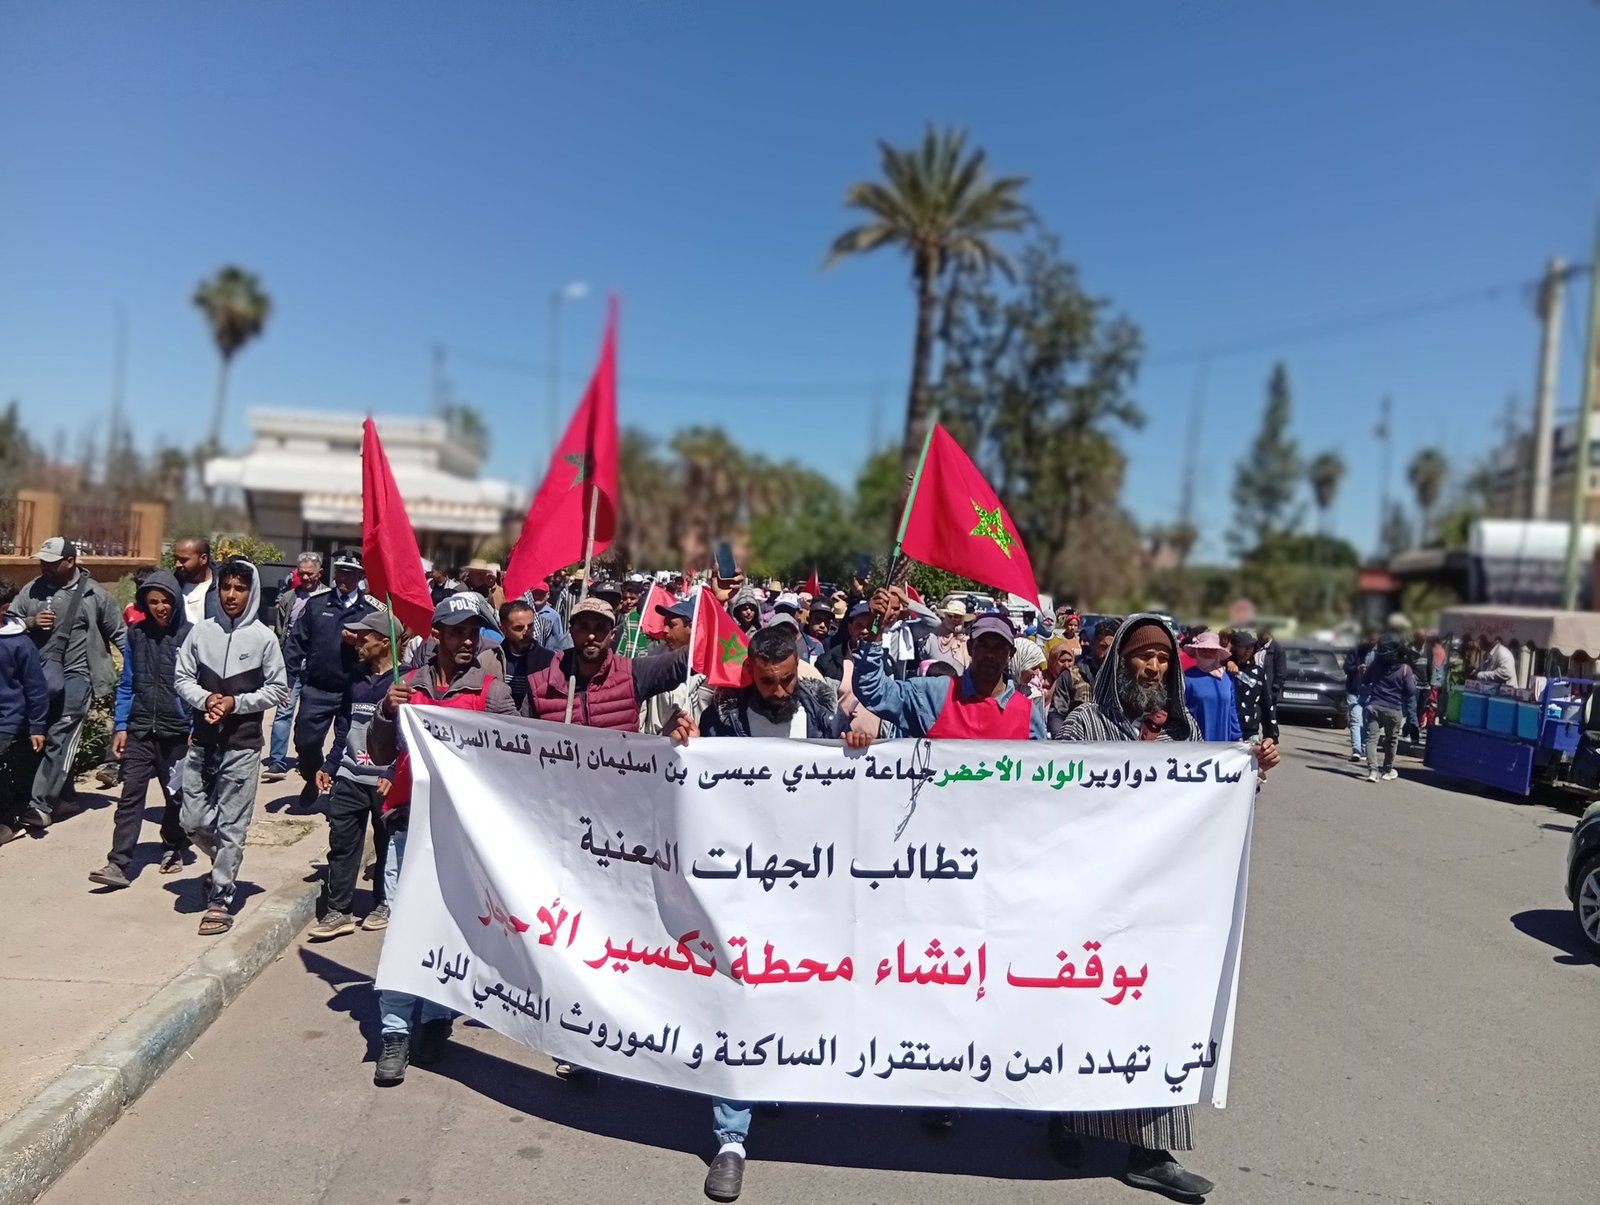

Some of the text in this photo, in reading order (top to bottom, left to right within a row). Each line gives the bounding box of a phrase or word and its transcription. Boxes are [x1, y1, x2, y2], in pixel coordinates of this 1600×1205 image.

[492, 729, 531, 755] قلعة
[538, 740, 580, 770] إقليم
[587, 745, 657, 777] اسليمان
[665, 760, 688, 786] بن
[698, 763, 772, 790] عيسى
[782, 761, 856, 793] سيدي
[865, 755, 937, 783] جماعة
[1031, 759, 1084, 790] الواد
[1080, 759, 1157, 788] دواوير
[1166, 758, 1242, 785] ساكنة
[578, 815, 979, 893] تطالب الجهات المعنية
[421, 945, 471, 984] للواد
[583, 930, 718, 978] تكسير
[727, 936, 854, 989] محطة
[875, 938, 986, 1002] إنشاء
[1006, 940, 1148, 1006] بوقف
[472, 981, 551, 1023] الطبيعي
[560, 1002, 681, 1057] الموروث
[683, 1042, 703, 1070] و
[714, 1030, 837, 1067] الساكنة
[845, 1035, 993, 1083] واستقرار
[1005, 1042, 1063, 1083] امن
[1078, 1043, 1152, 1085] تهدد
